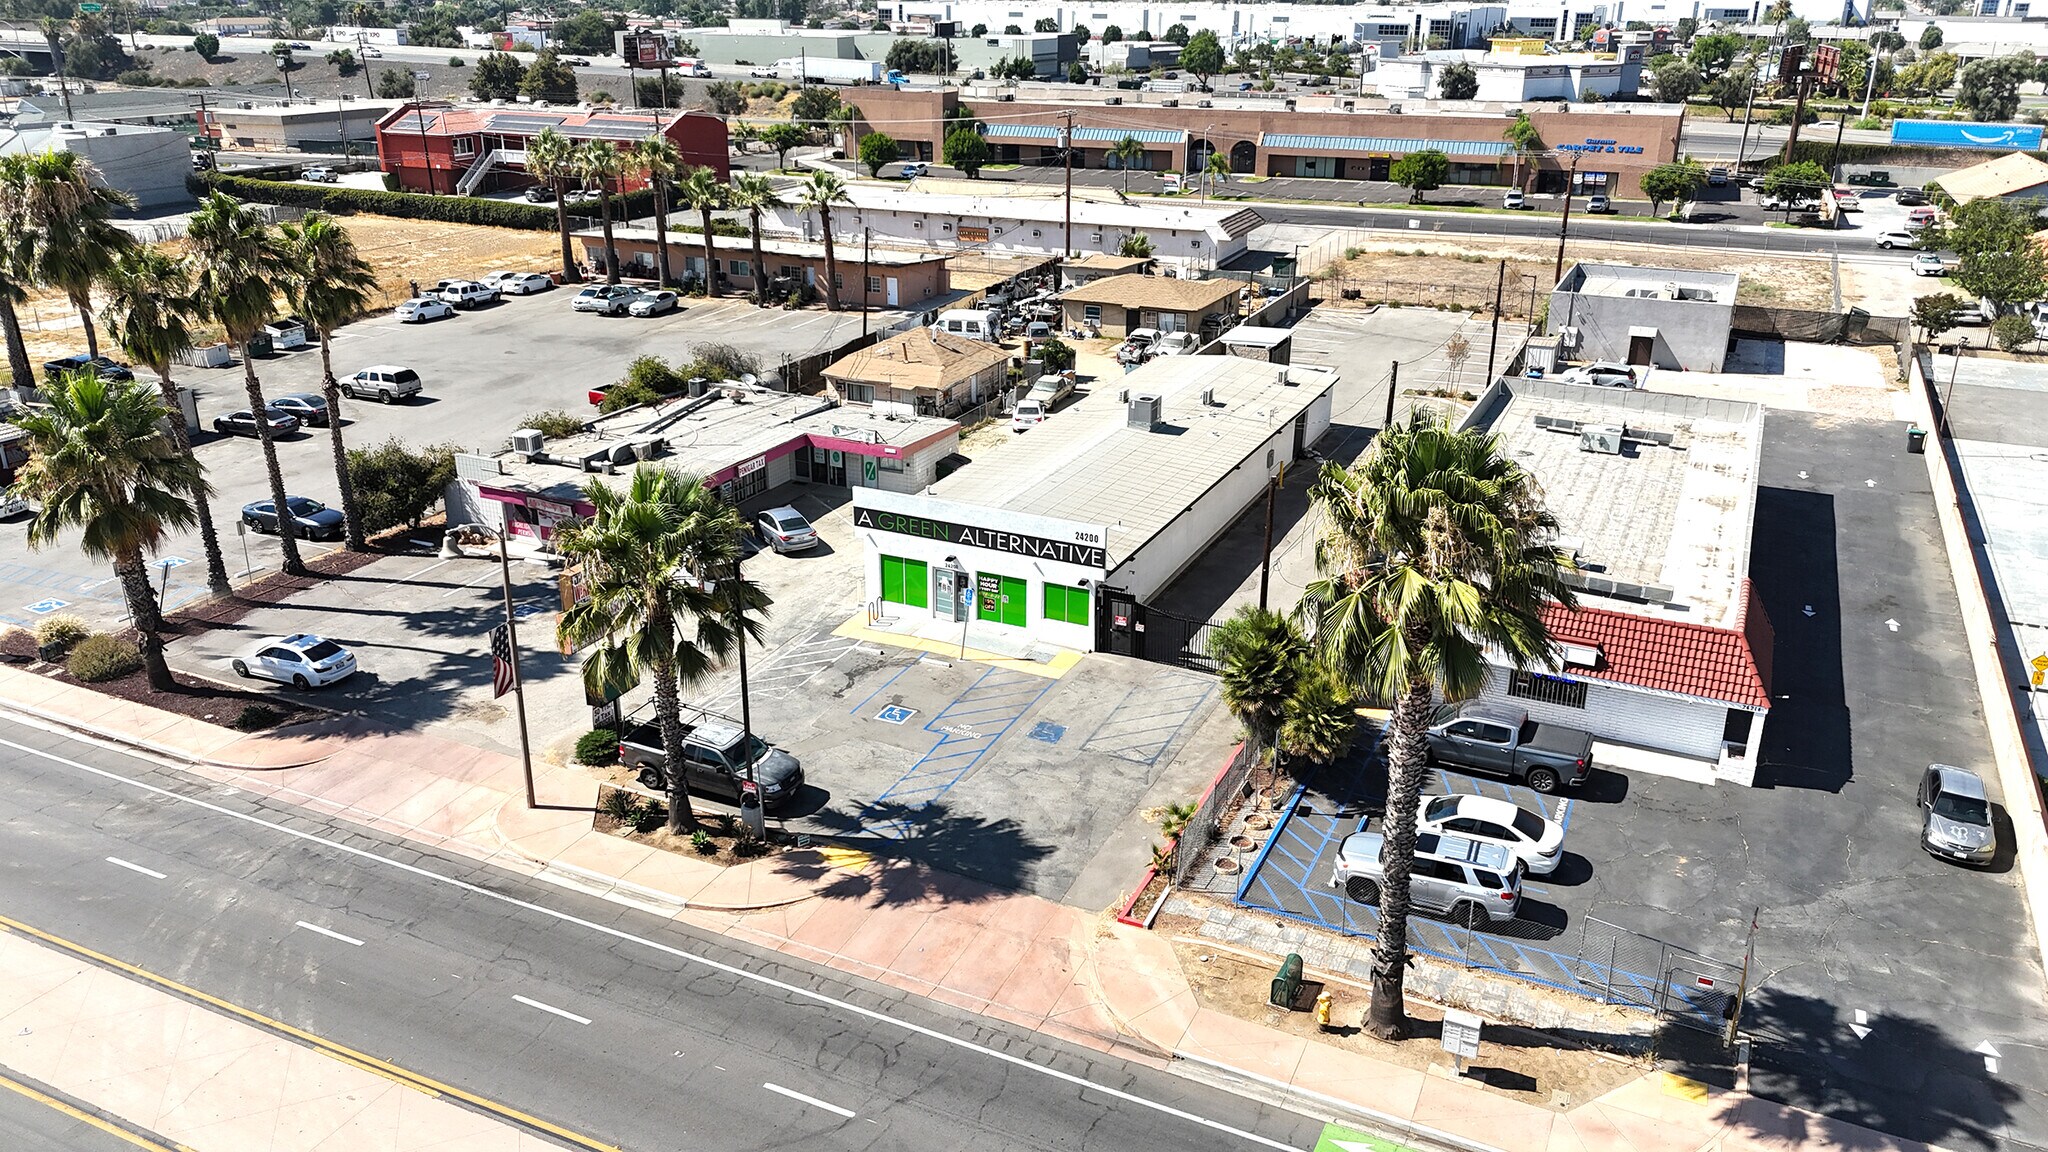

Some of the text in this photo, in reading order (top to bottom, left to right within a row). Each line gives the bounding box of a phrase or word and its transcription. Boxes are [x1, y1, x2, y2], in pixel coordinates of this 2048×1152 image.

[1556, 143, 1644, 154] CARPET & TILE
[755, 458, 765, 469] TAX
[858, 510, 1104, 567] A GREEN ALTERNATIVE
[1075, 531, 1099, 543] 24200
[980, 581, 998, 589] HOUR
[940, 725, 982, 739] PARKING
[1552, 797, 1569, 826] ARKING
